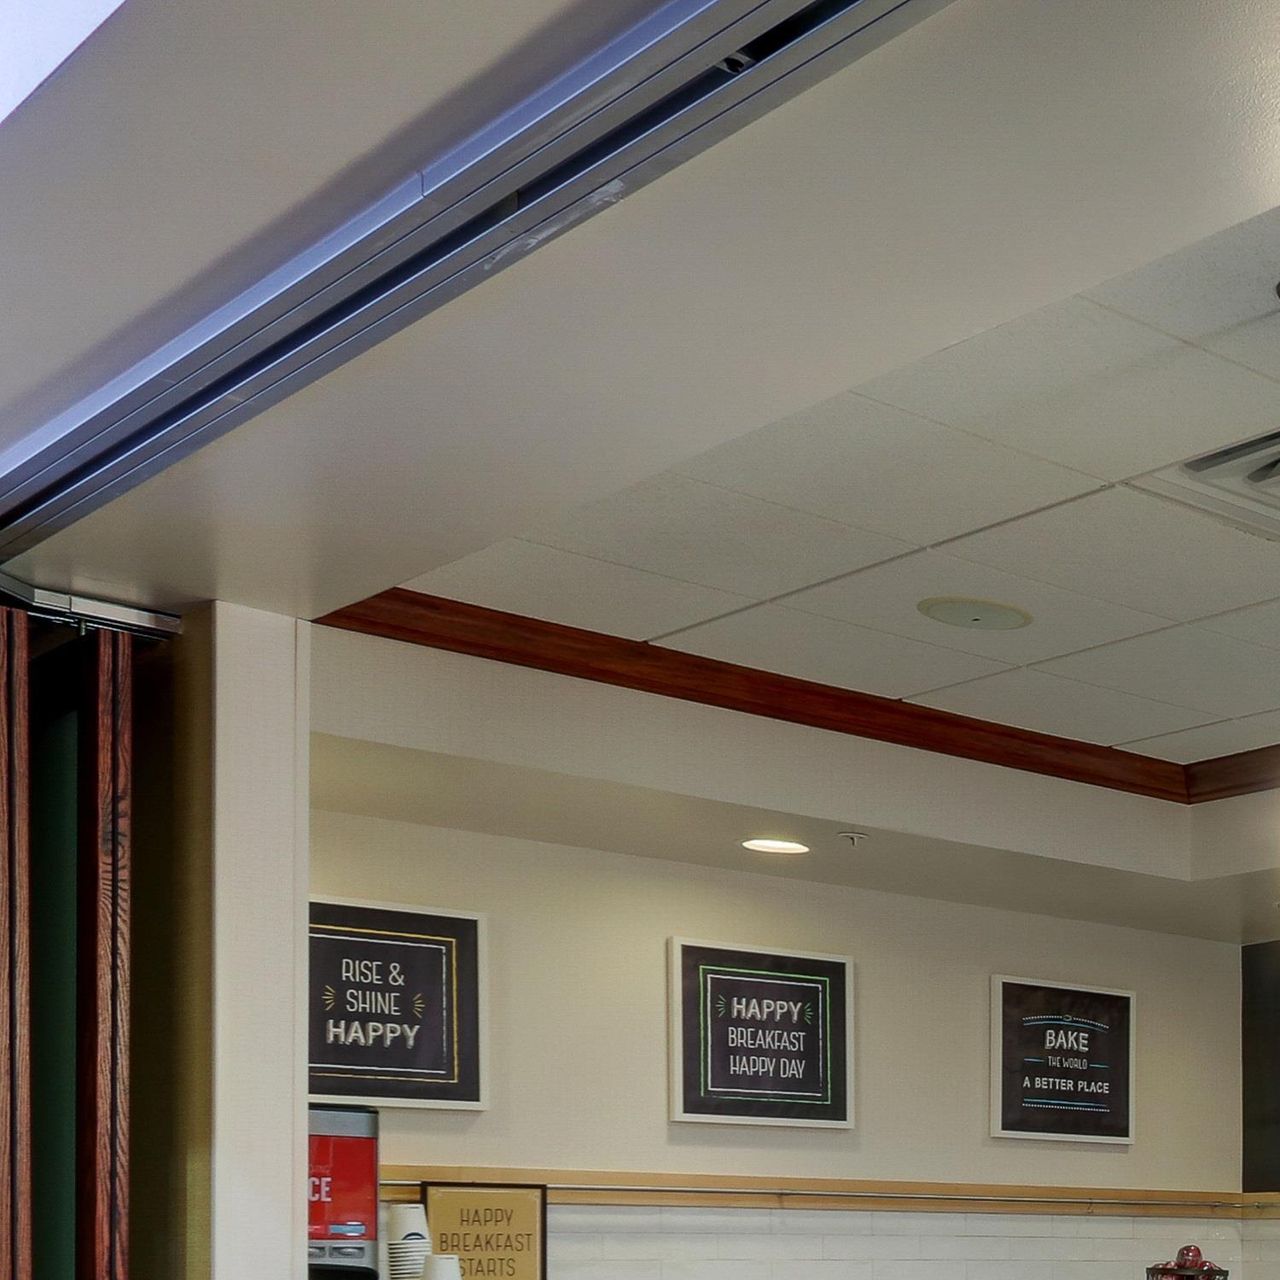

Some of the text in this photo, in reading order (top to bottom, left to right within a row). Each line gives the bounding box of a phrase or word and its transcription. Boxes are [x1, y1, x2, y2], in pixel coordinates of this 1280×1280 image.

[342, 958, 405, 986] RISE &
[346, 989, 401, 1015] SHINE
[732, 996, 803, 1023] HAPPY
[326, 1019, 420, 1049] HAPPY
[728, 1026, 807, 1052] BREAKFAST
[1045, 1029, 1089, 1053] BAKE
[730, 1055, 806, 1079] HAPPY DAY
[1048, 1056, 1088, 1070] THE WORLD
[1022, 1076, 1110, 1094] A BETTER PLACE
[460, 1207, 514, 1227] HAPPY
[440, 1232, 533, 1252] BREAKFAST
[458, 1257, 516, 1277] STARTS
